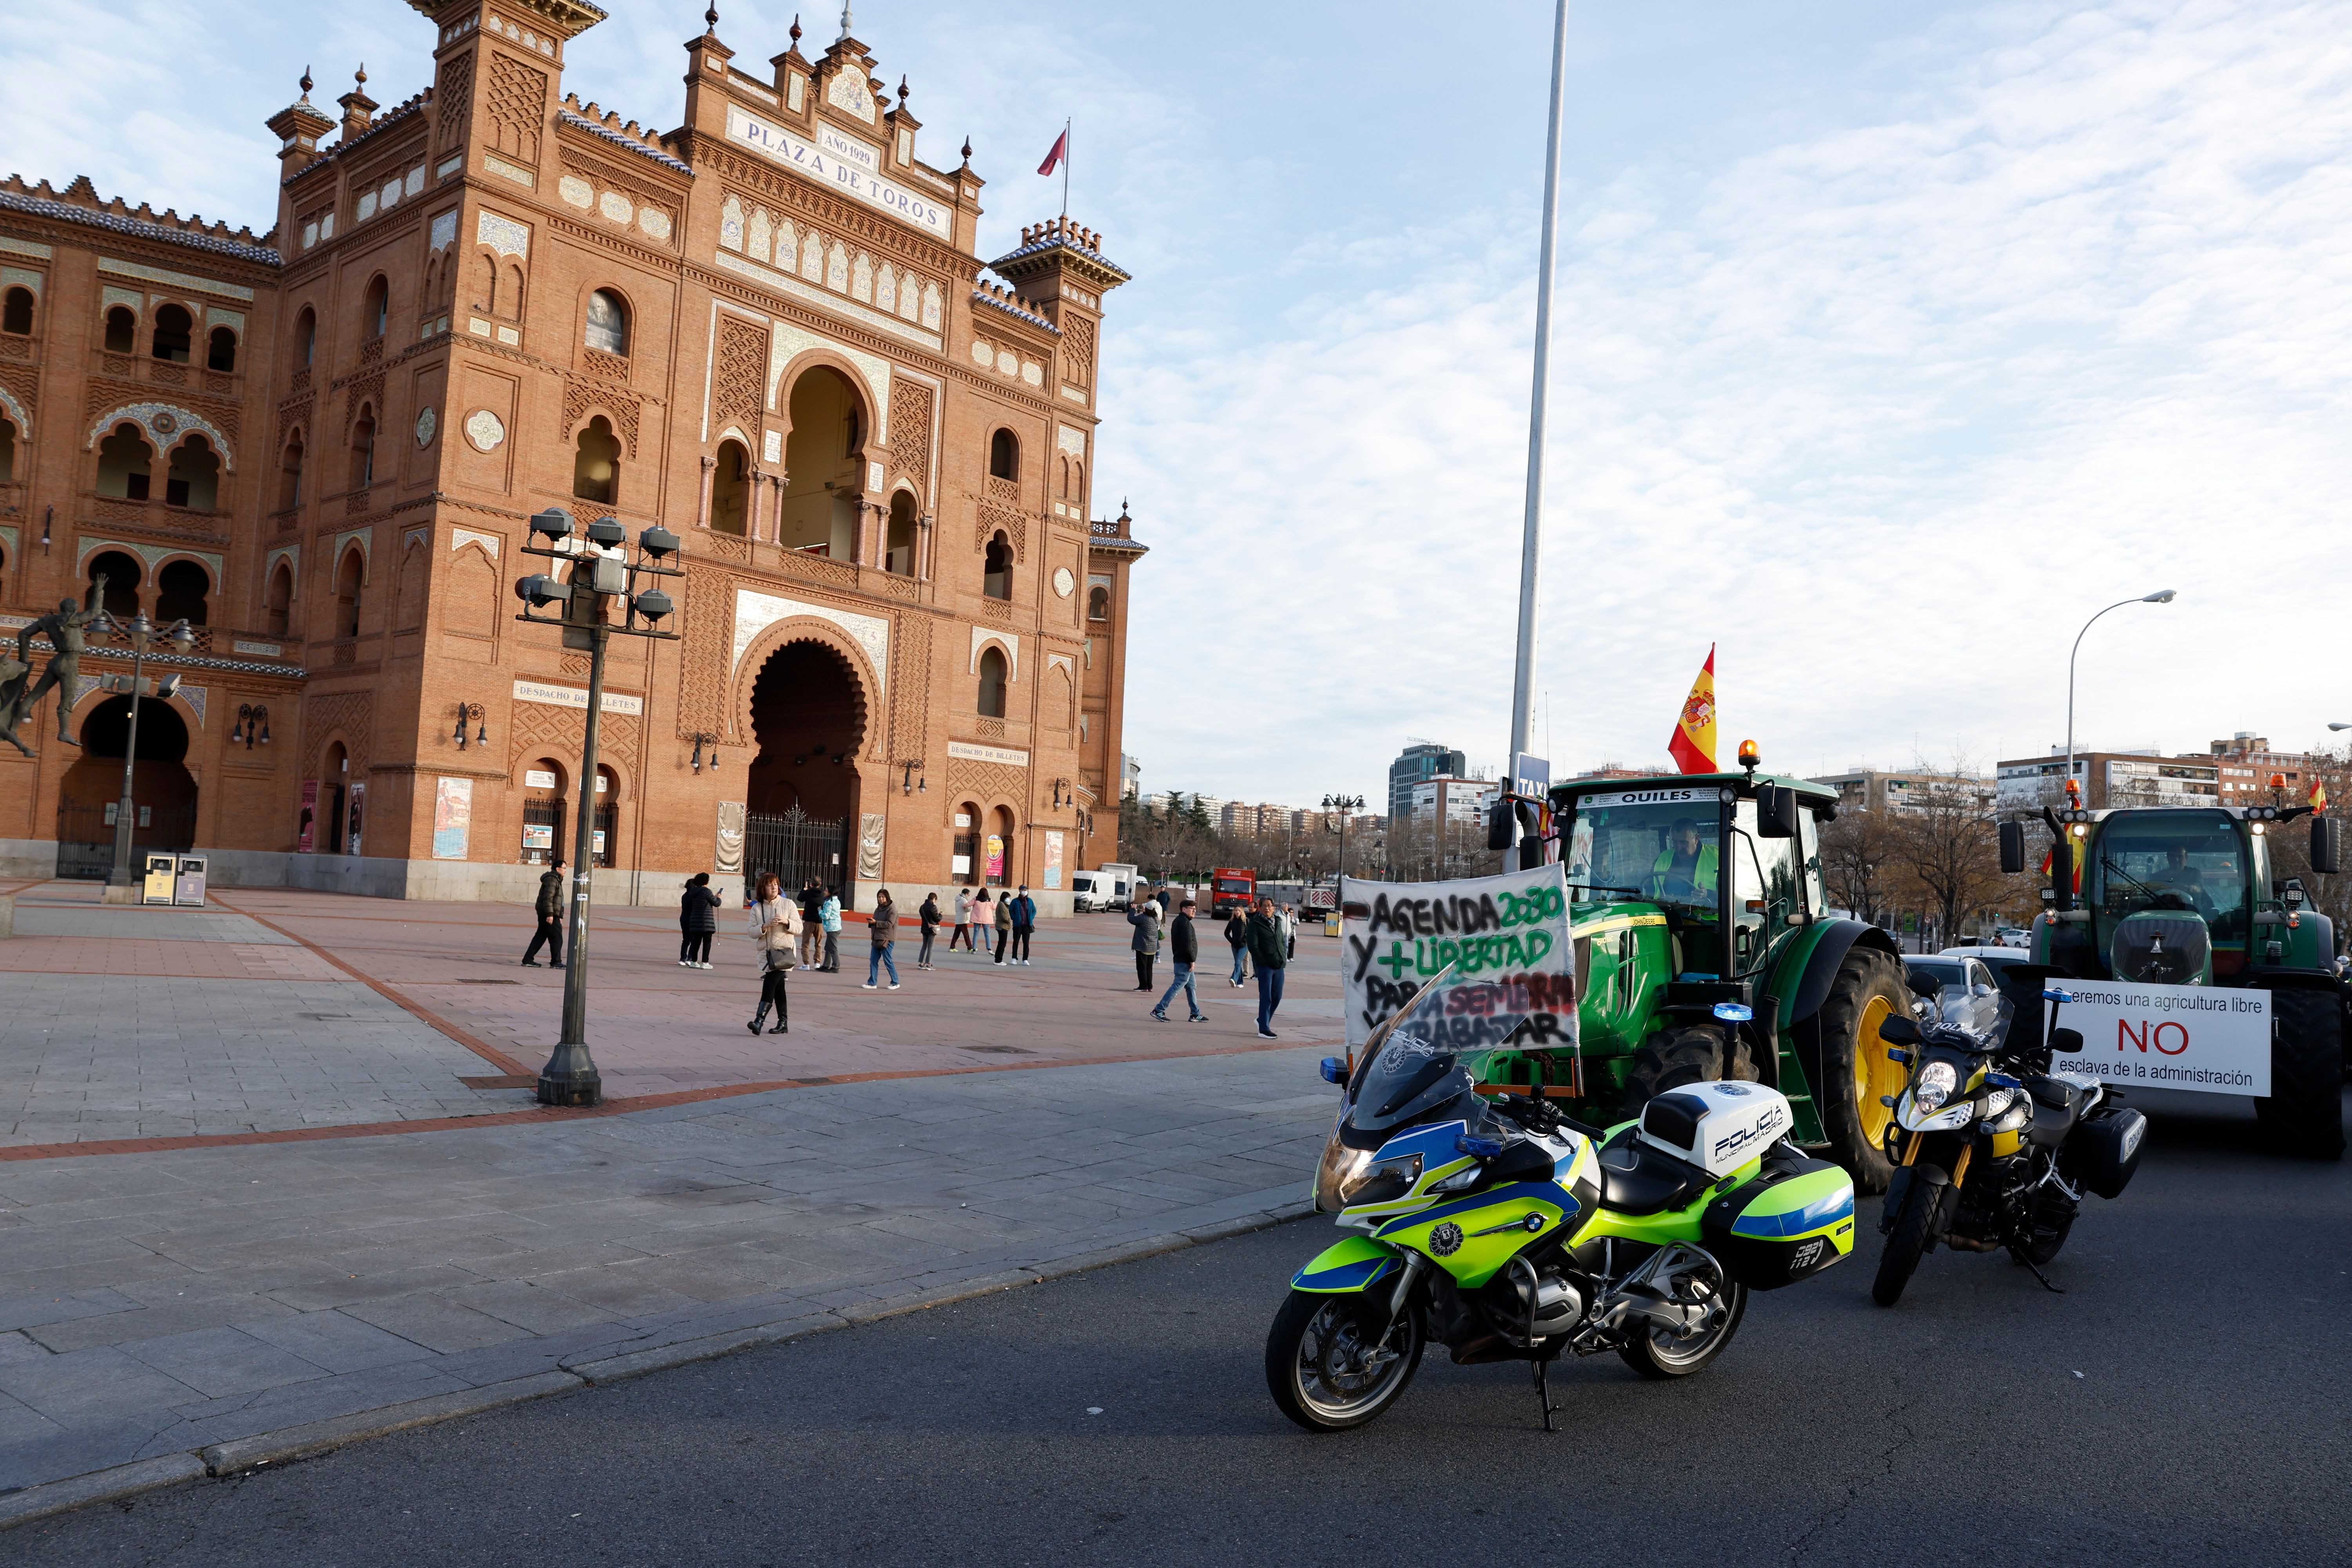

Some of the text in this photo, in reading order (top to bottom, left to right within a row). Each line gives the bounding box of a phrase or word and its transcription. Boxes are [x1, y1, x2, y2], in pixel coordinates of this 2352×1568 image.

[825, 134, 870, 164] AÑO 1929
[747, 122, 937, 225] PLAZA DE TOROS
[520, 686, 569, 700] DESPACHO
[601, 697, 636, 709] LLETES
[951, 746, 982, 756] DESPACHO
[996, 752, 1024, 761] BILLETES
[1520, 778, 1547, 800] TAXI
[1622, 791, 1691, 803] QUILES
[1369, 893, 1501, 940] AGENDA
[1498, 886, 1563, 927] 2030
[1349, 933, 1377, 982] Y
[2054, 987, 2262, 1013] eremos una agricultura libre
[1403, 1042, 1430, 1057] MADRID
[2118, 1019, 2189, 1055] NO
[2060, 1058, 2252, 1086] esclava de la administración
[1715, 1104, 1783, 1157] POLICÍA
[1716, 1117, 1783, 1164] MUNICIPAL MADRID
[1790, 1256, 1811, 1270] 112
[1796, 1241, 1819, 1258] 092
